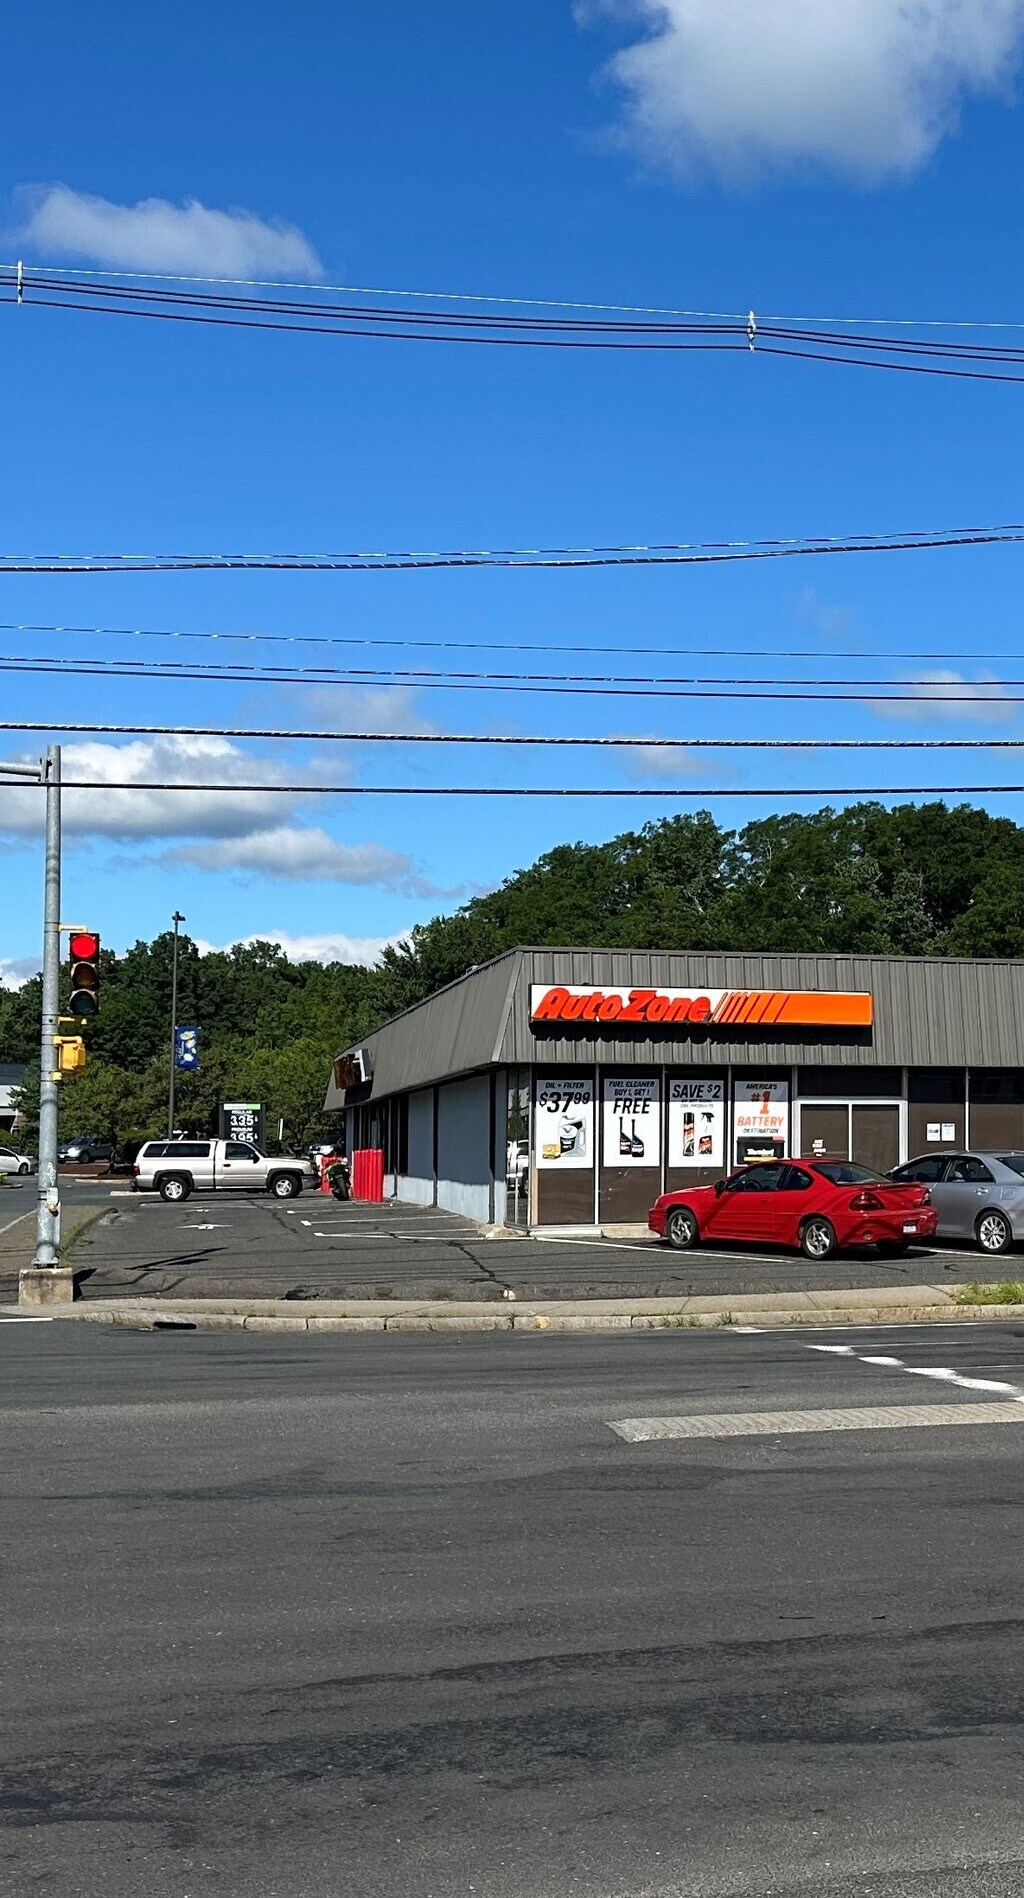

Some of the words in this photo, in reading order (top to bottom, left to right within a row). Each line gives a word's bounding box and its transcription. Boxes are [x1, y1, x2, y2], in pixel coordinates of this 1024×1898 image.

[533, 987, 712, 1023] AutoZone
[672, 1084, 705, 1098] SAVE
[707, 1084, 721, 1098] $2
[613, 1097, 652, 1114] FREE
[751, 1091, 771, 1114] #1
[737, 1116, 784, 1127] BATTERY
